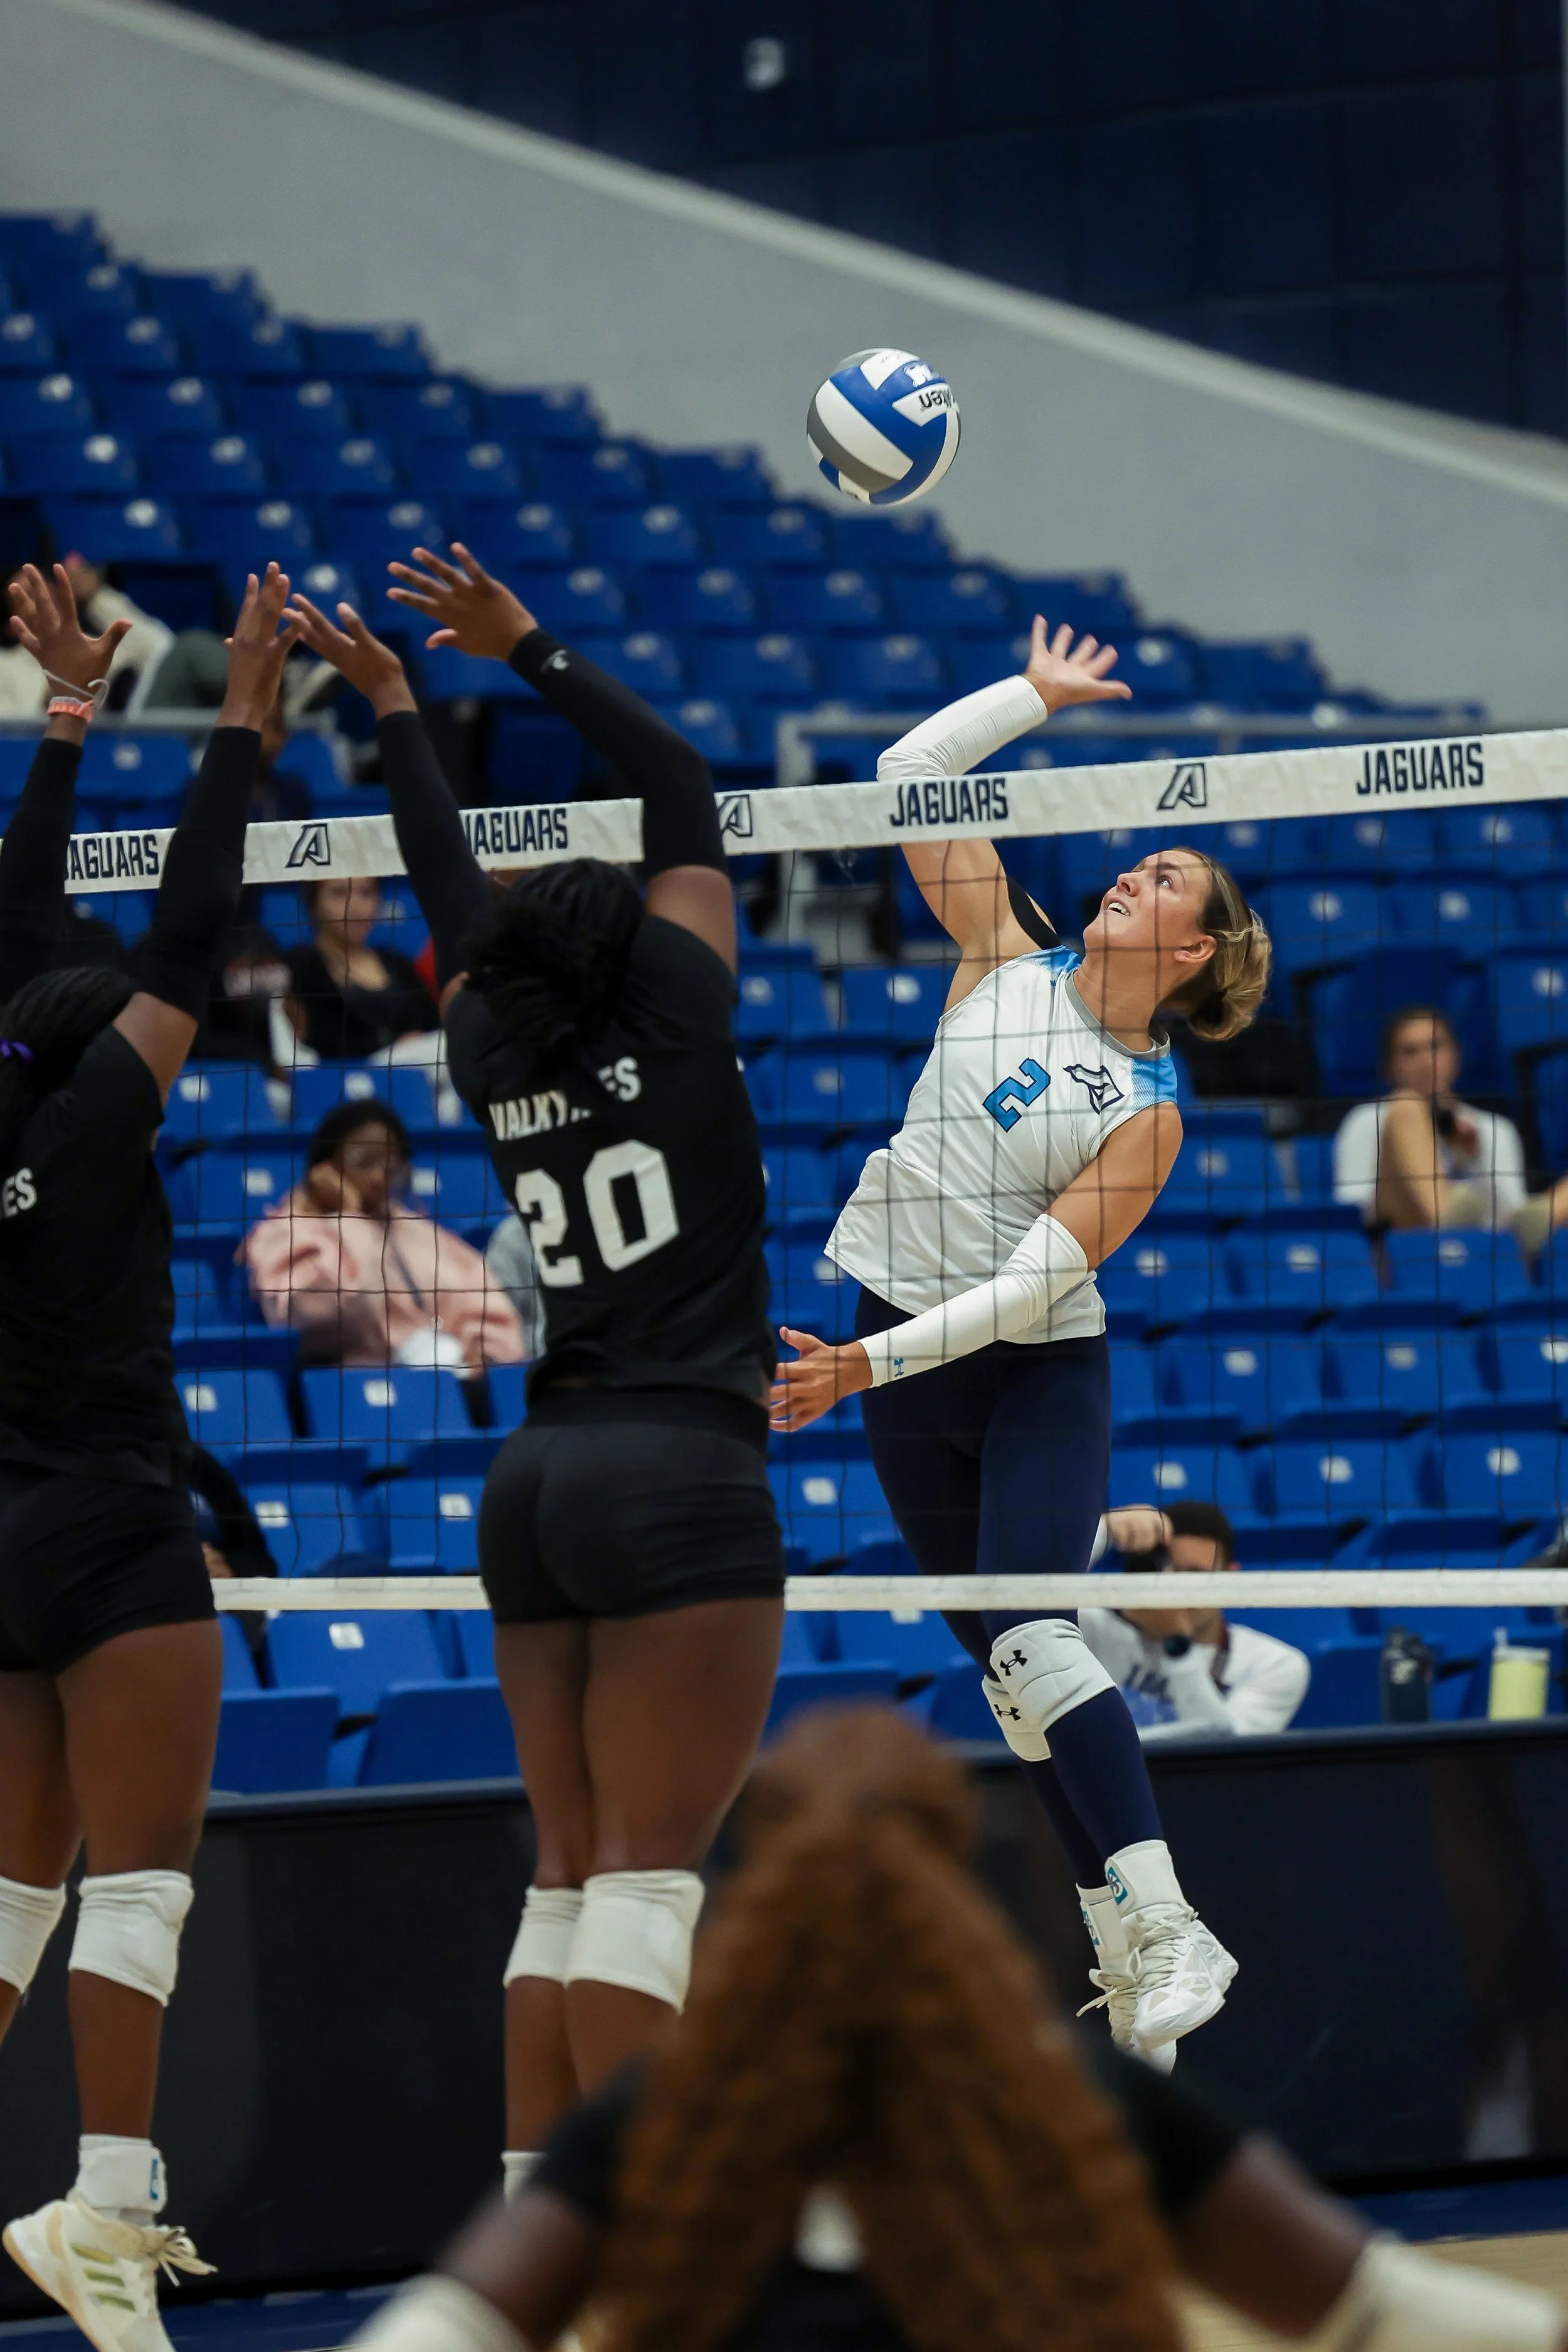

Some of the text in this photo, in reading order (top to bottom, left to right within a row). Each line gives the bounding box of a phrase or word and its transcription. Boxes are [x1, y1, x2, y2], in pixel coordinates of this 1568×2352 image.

[1356, 742, 1484, 796] JAGUARS
[889, 778, 1009, 828] JAGUARS
[66, 834, 159, 880] AGUARS
[489, 1056, 641, 1141] VALKYS
[982, 1057, 1051, 1133] 2
[515, 1139, 679, 1288] 20
